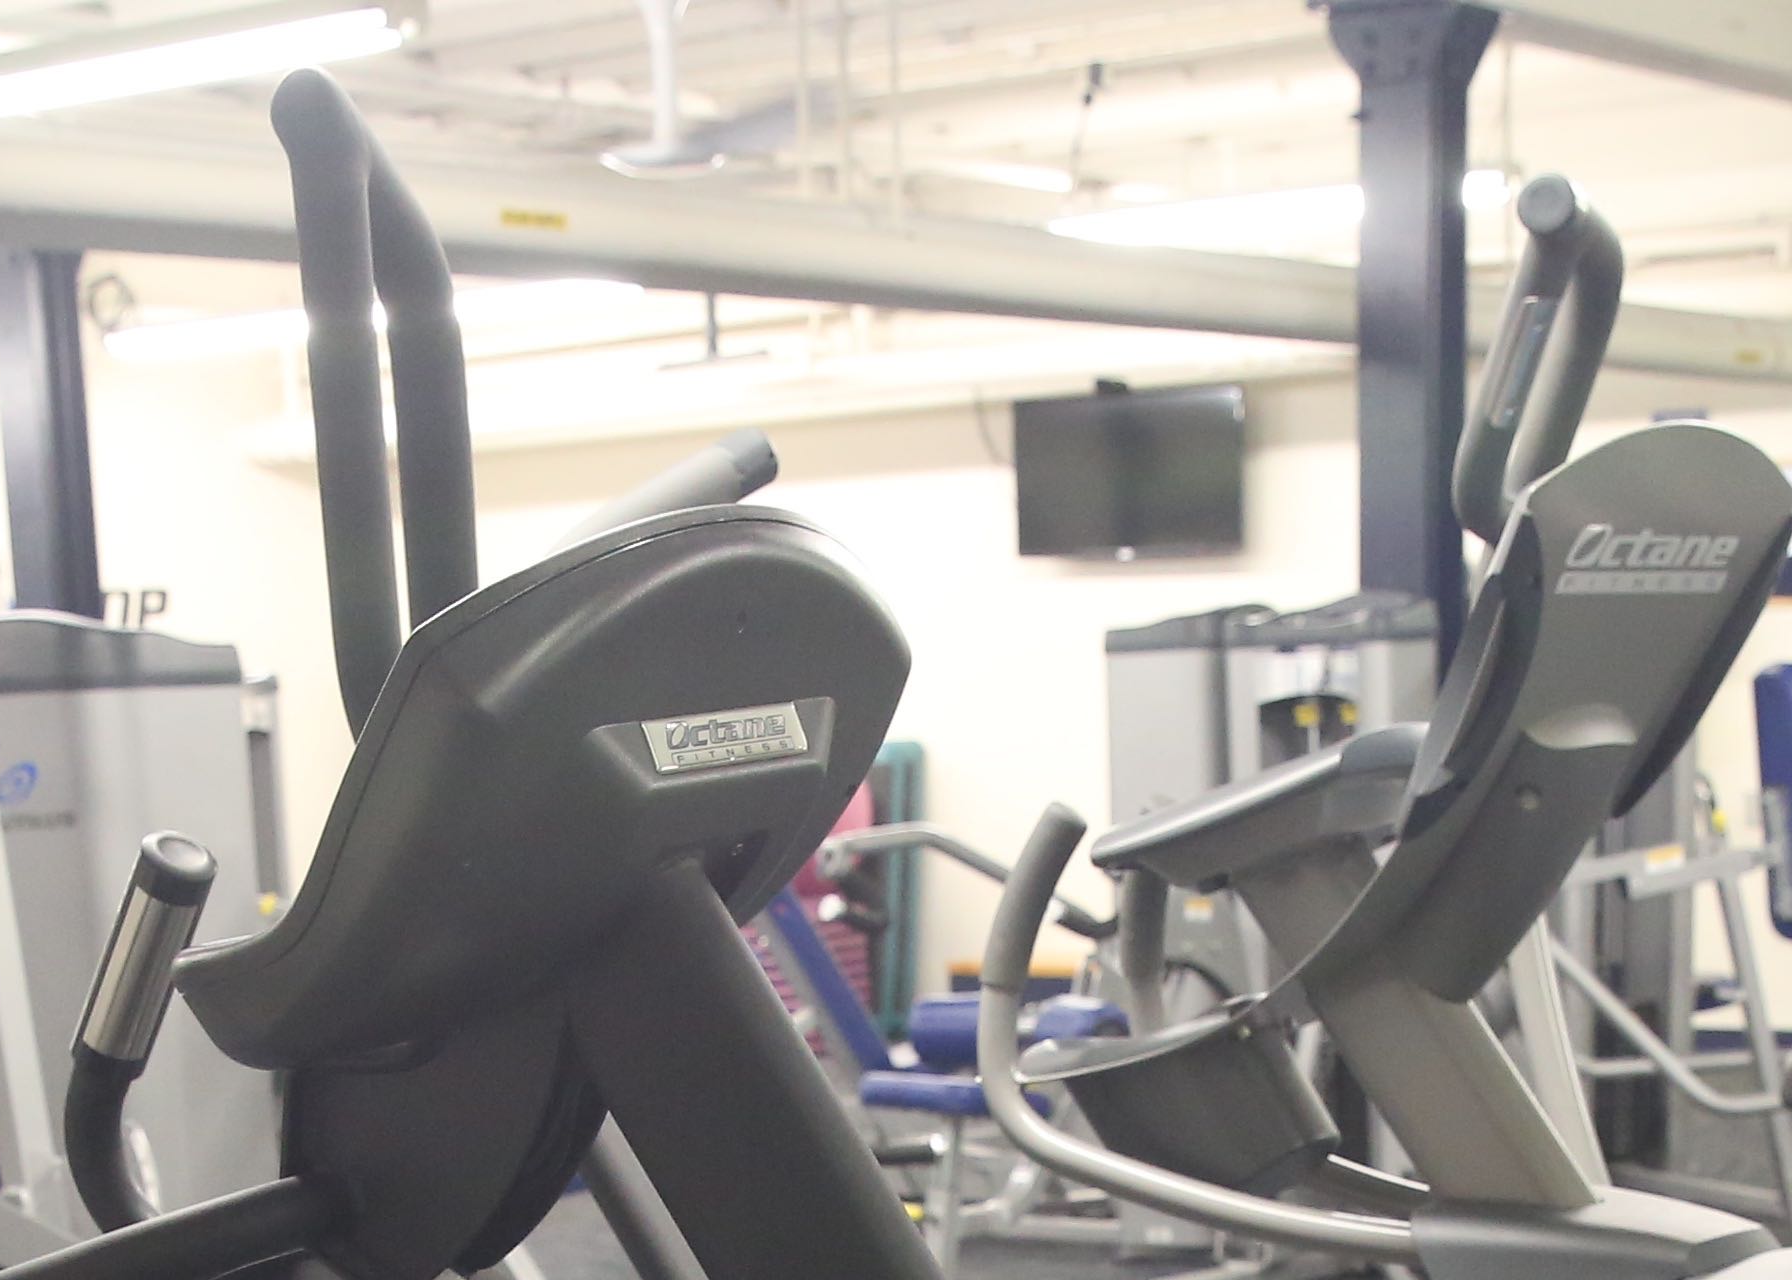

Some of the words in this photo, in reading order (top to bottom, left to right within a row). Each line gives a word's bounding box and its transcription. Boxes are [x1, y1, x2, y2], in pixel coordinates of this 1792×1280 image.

[1564, 523, 1740, 569] Octane
[665, 714, 786, 750] Octane
[677, 740, 788, 763] FITNESS
